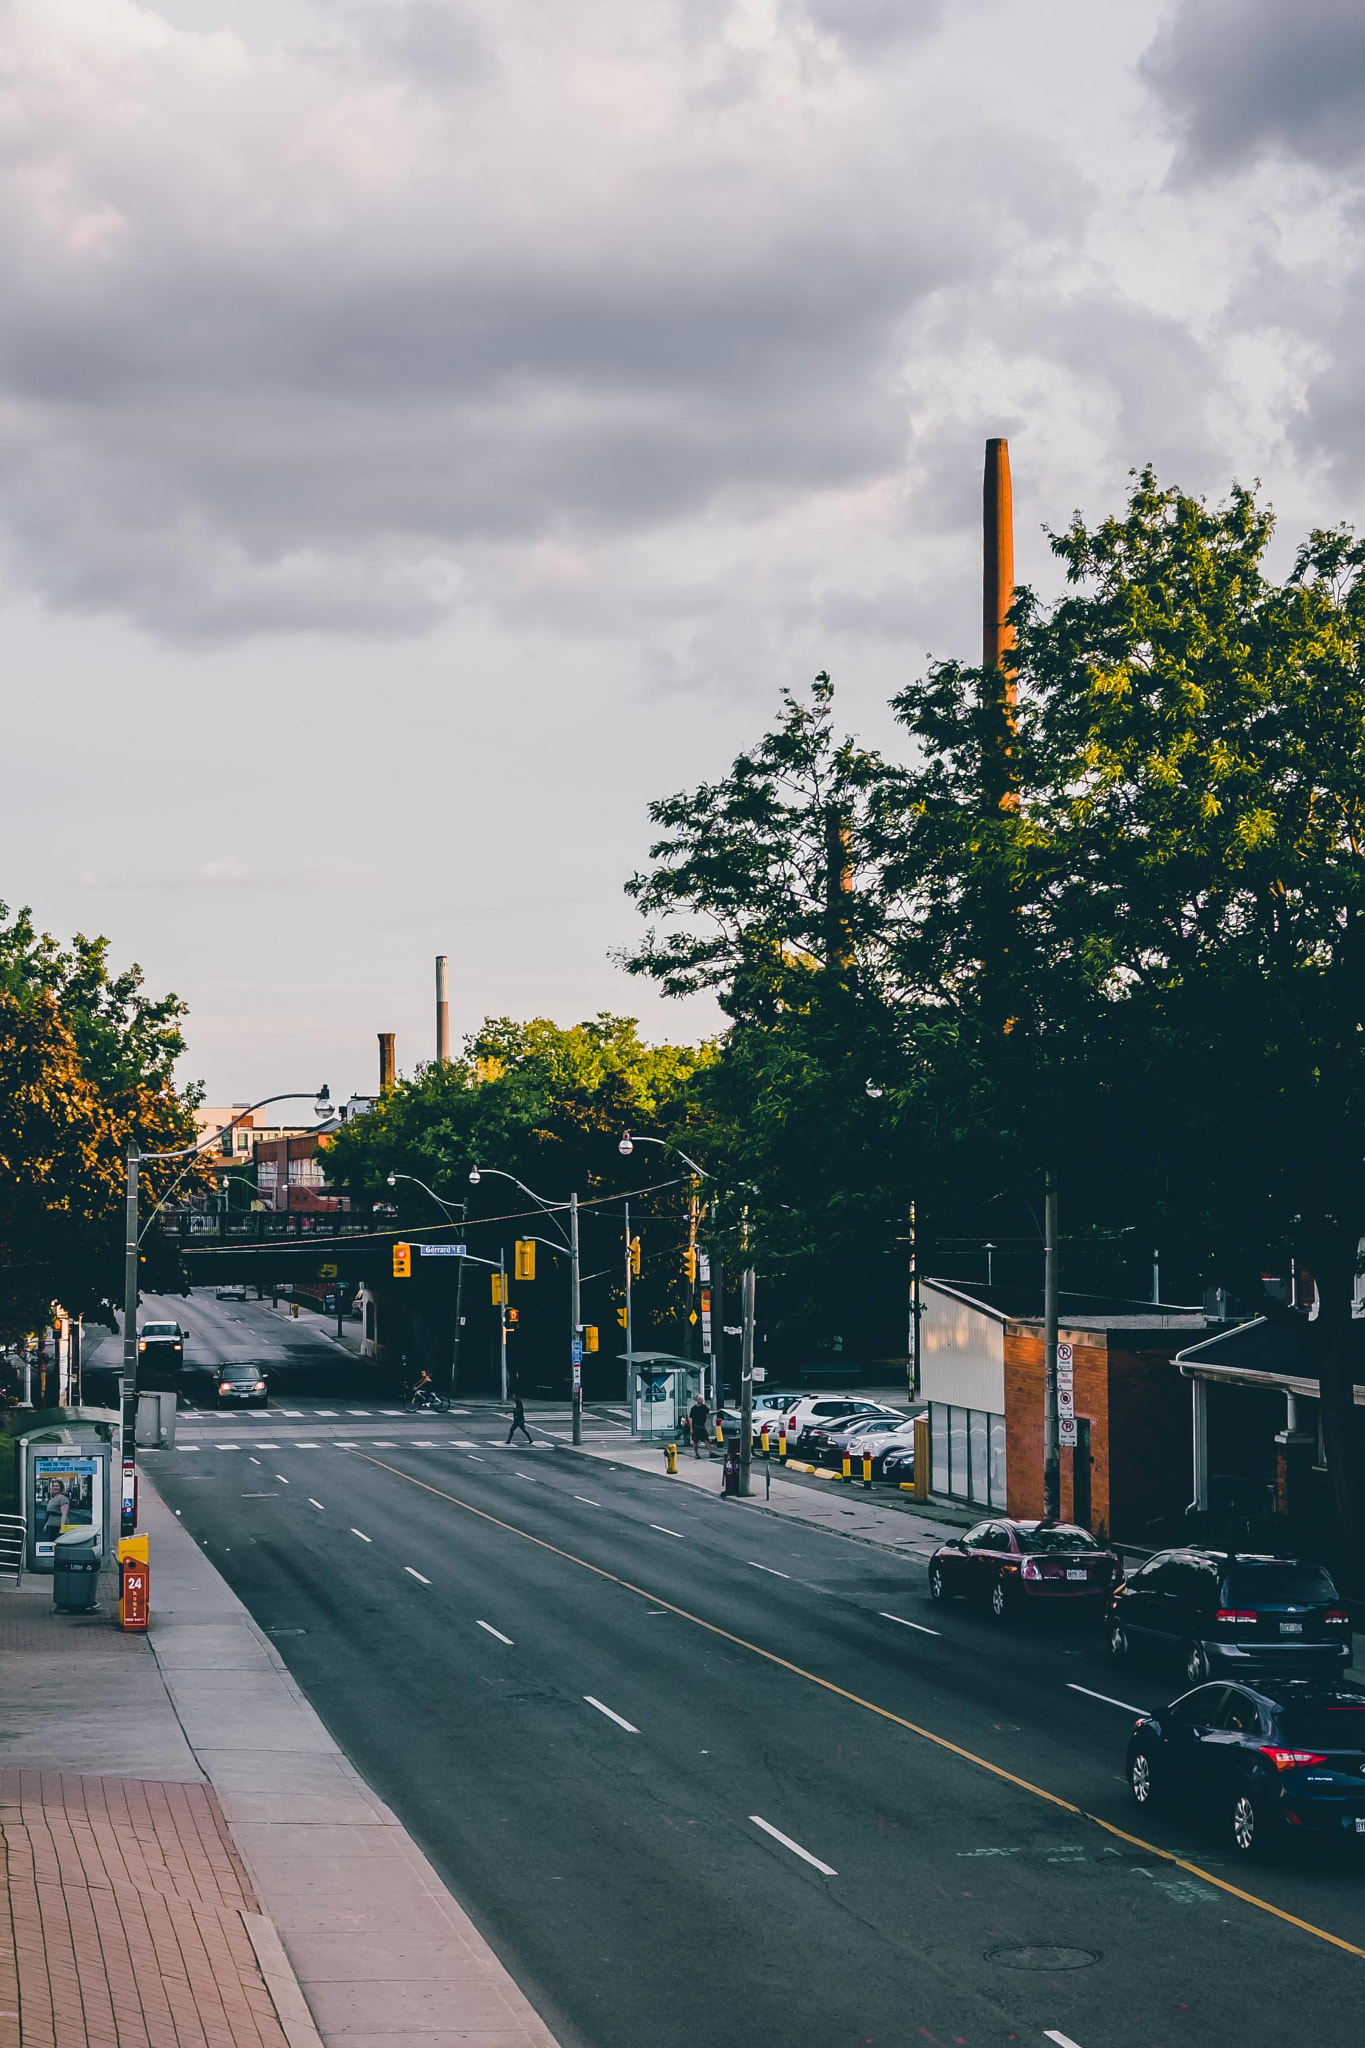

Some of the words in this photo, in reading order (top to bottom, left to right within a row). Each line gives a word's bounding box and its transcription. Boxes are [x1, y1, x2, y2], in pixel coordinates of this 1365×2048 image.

[426, 1246, 450, 1254] Gerrard
[128, 1577, 142, 1589] 24
[1356, 1821, 1365, 1831] BY
